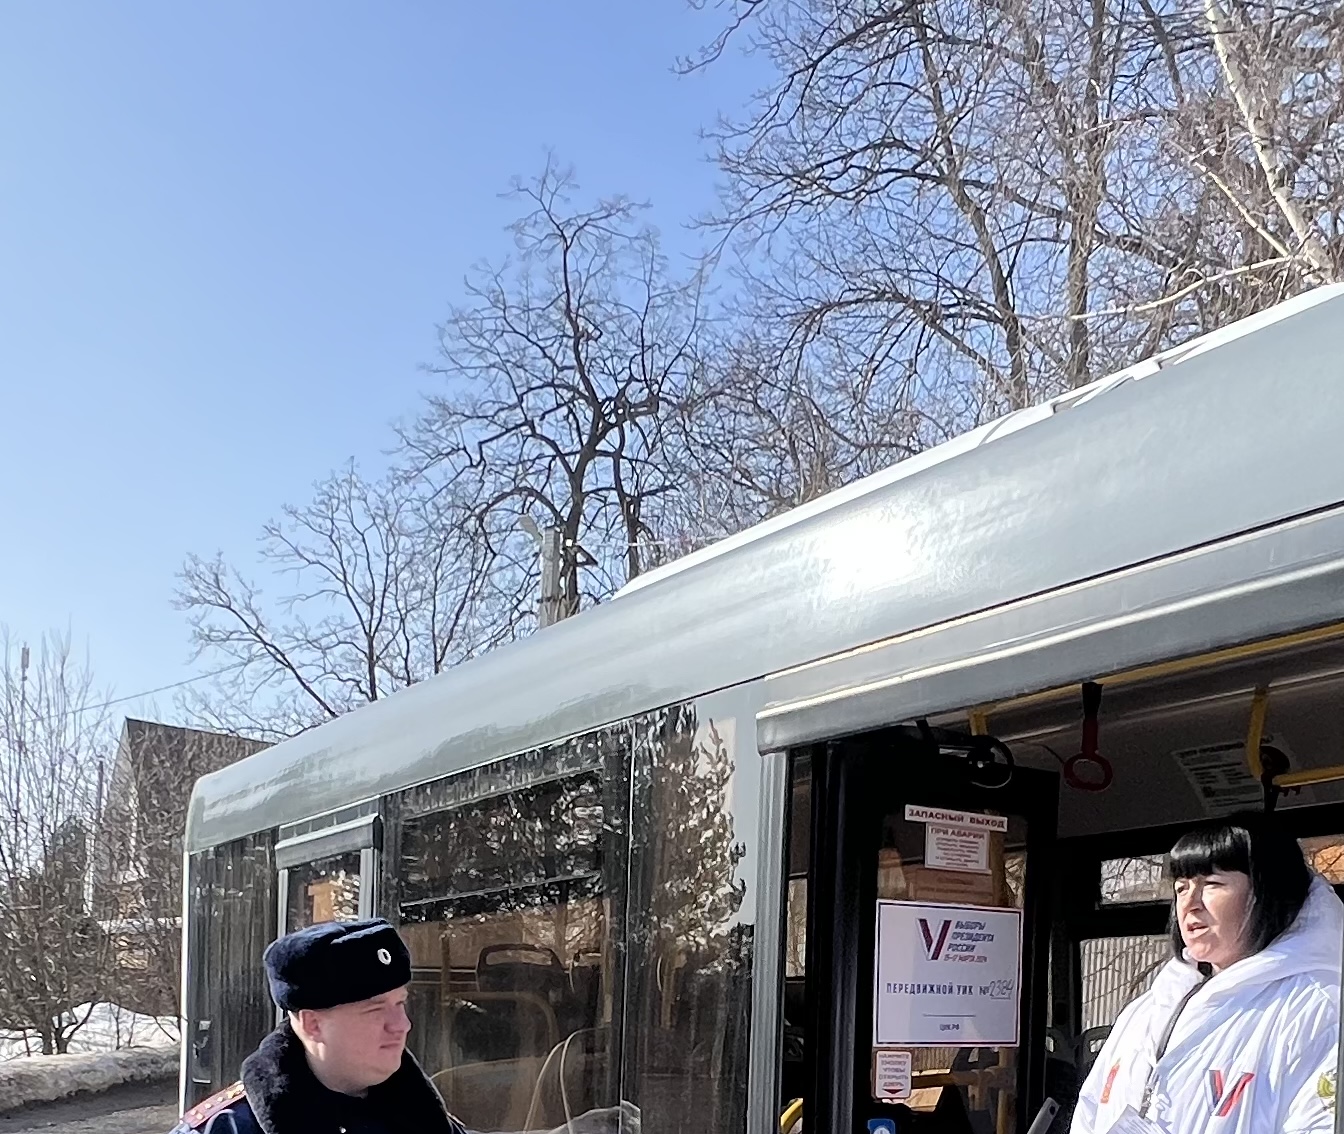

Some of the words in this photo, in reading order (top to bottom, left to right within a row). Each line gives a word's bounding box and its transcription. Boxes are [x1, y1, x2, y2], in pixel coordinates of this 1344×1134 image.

[908, 808, 964, 823] ЗАПАСНЫЙ
[969, 817, 1005, 829] ВЫХОД
[929, 827, 948, 835] ПРИ
[950, 829, 985, 839] АВАРИИ
[886, 982, 953, 995] ПЕРЕДВИЖНОЙ
[956, 985, 973, 995] УИК
